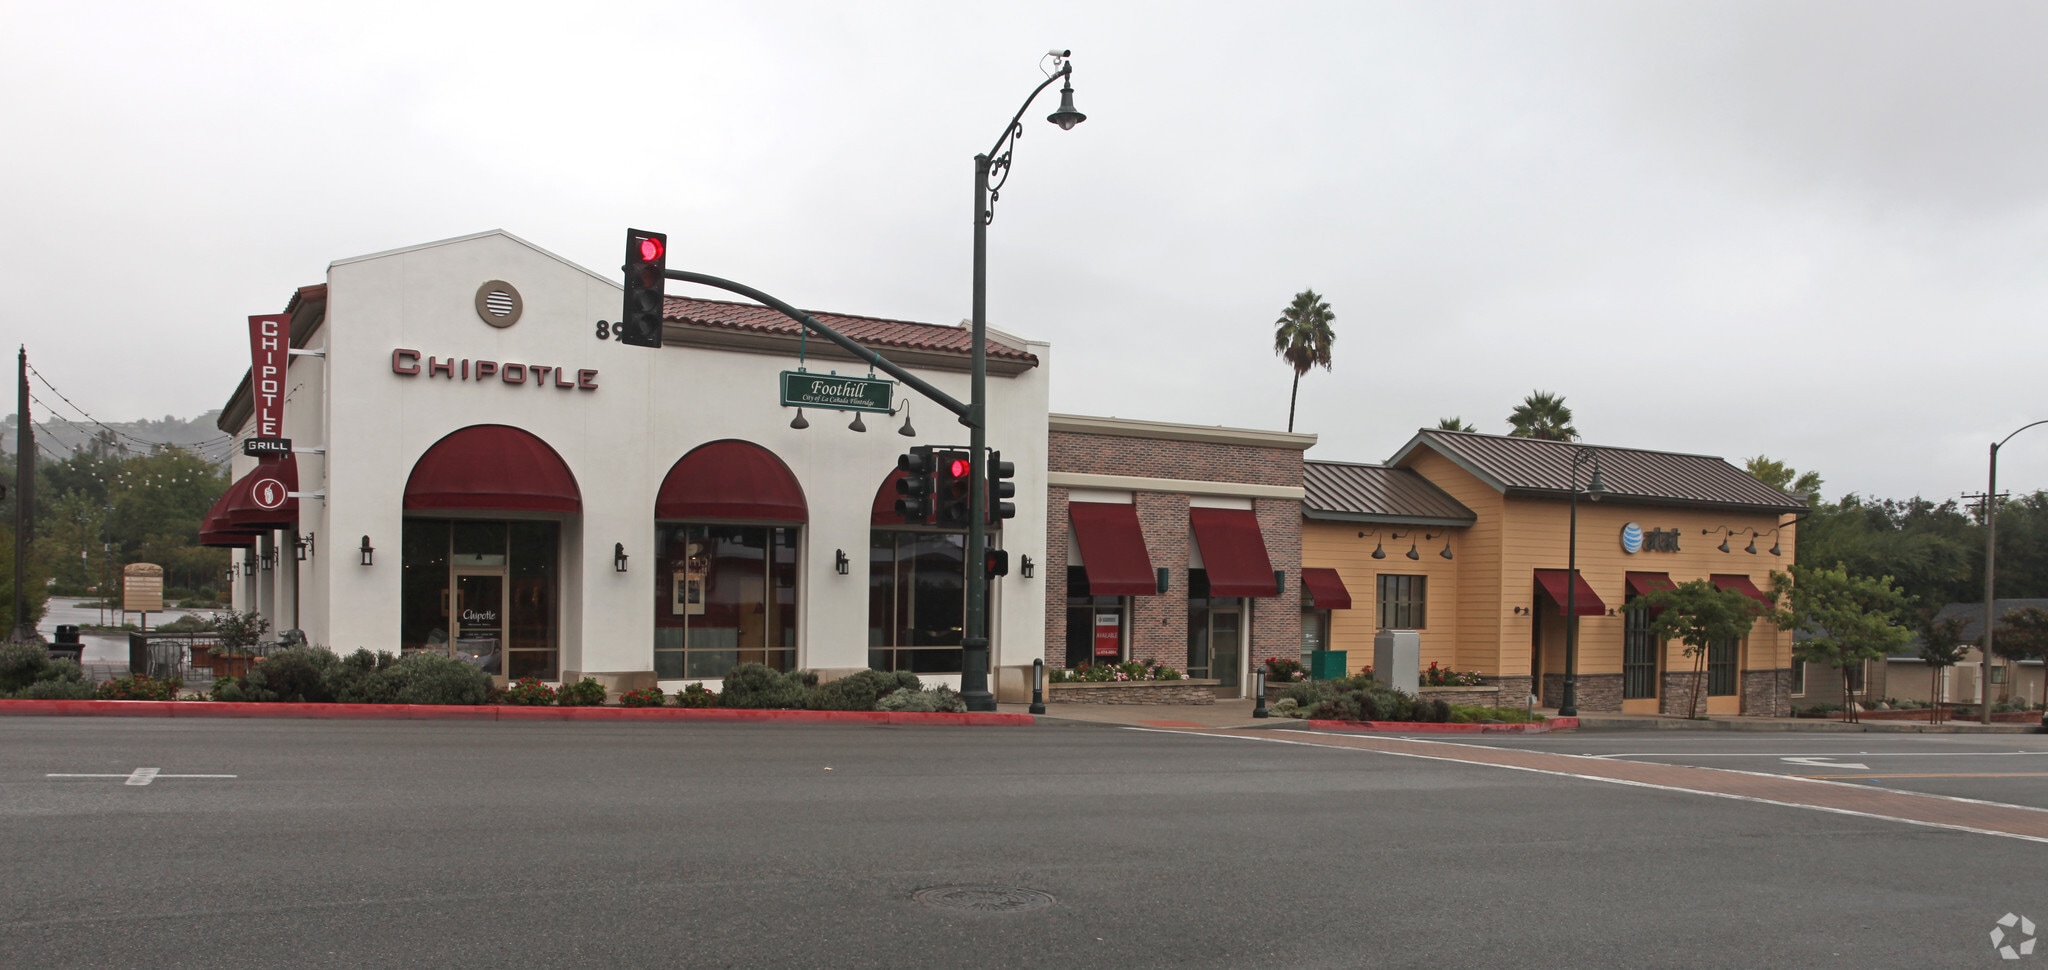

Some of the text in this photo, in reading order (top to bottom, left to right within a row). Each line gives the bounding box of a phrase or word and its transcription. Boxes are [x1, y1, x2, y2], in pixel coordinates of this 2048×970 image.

[392, 348, 599, 390] CHIPOTLE
[261, 320, 278, 436] CHIPOTLE
[811, 380, 868, 398] Foothill
[802, 394, 814, 403] City
[814, 394, 822, 402] of
[850, 398, 875, 407] Flintridge
[248, 440, 288, 451] GRILL
[463, 609, 496, 622] Chipotle
